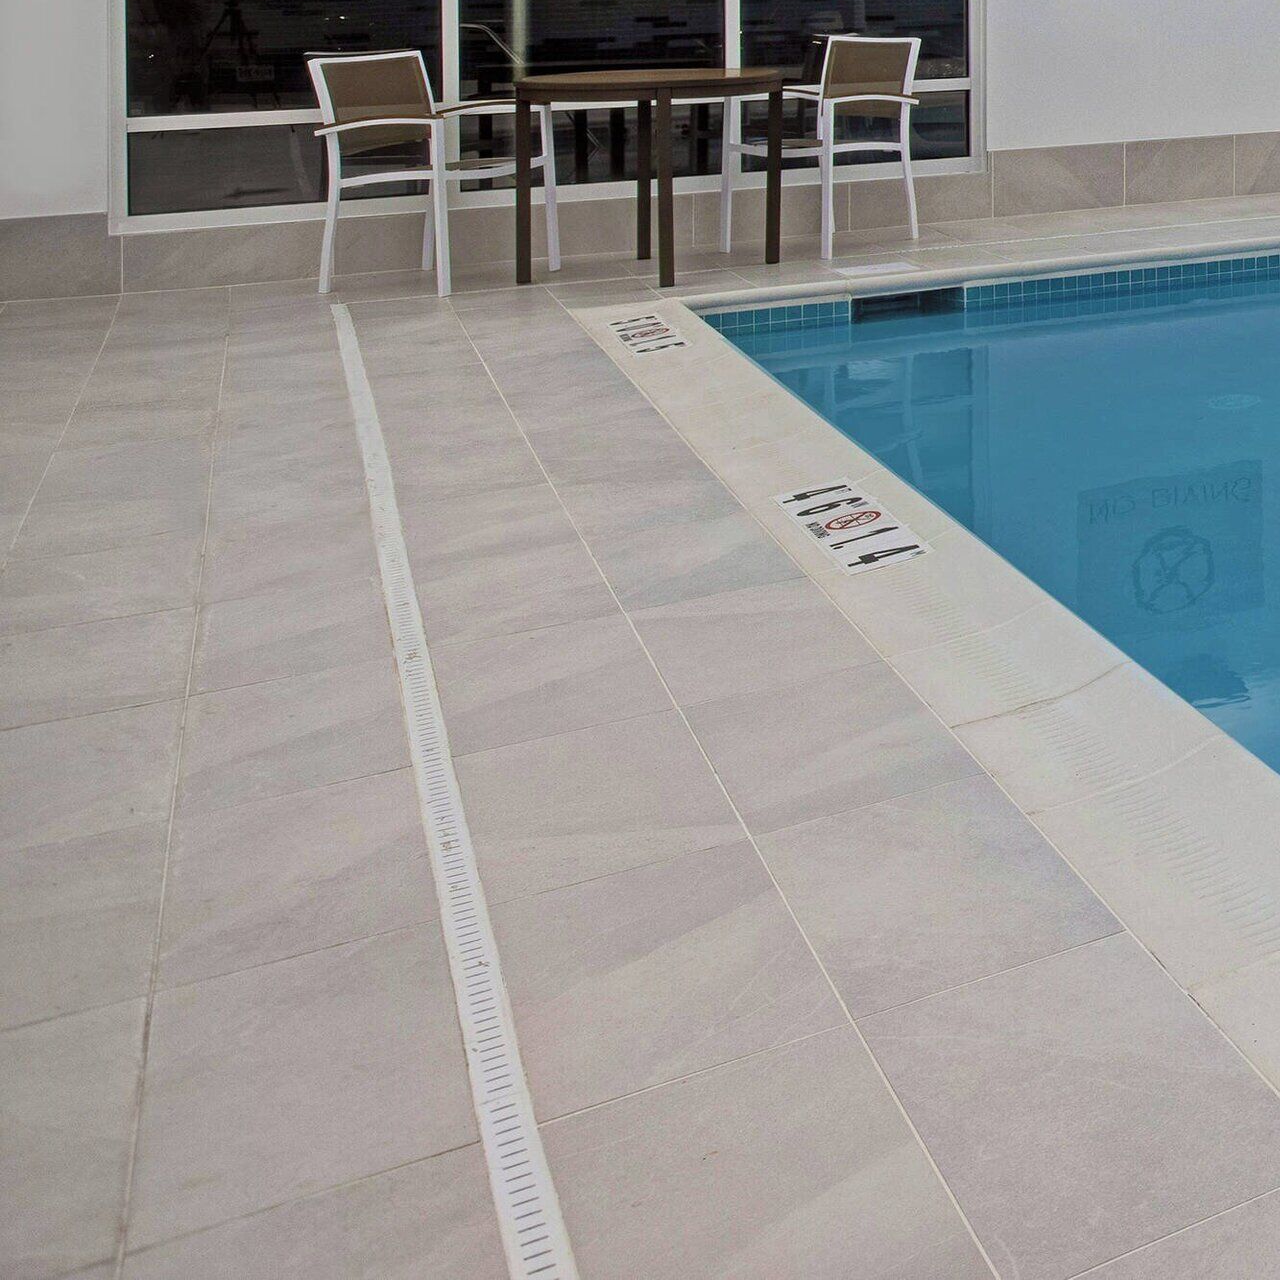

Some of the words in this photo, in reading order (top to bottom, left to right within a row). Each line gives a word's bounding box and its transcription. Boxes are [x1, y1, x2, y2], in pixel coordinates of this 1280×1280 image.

[783, 484, 848, 504] 4
[797, 497, 863, 517] 6
[848, 544, 920, 567] 4
